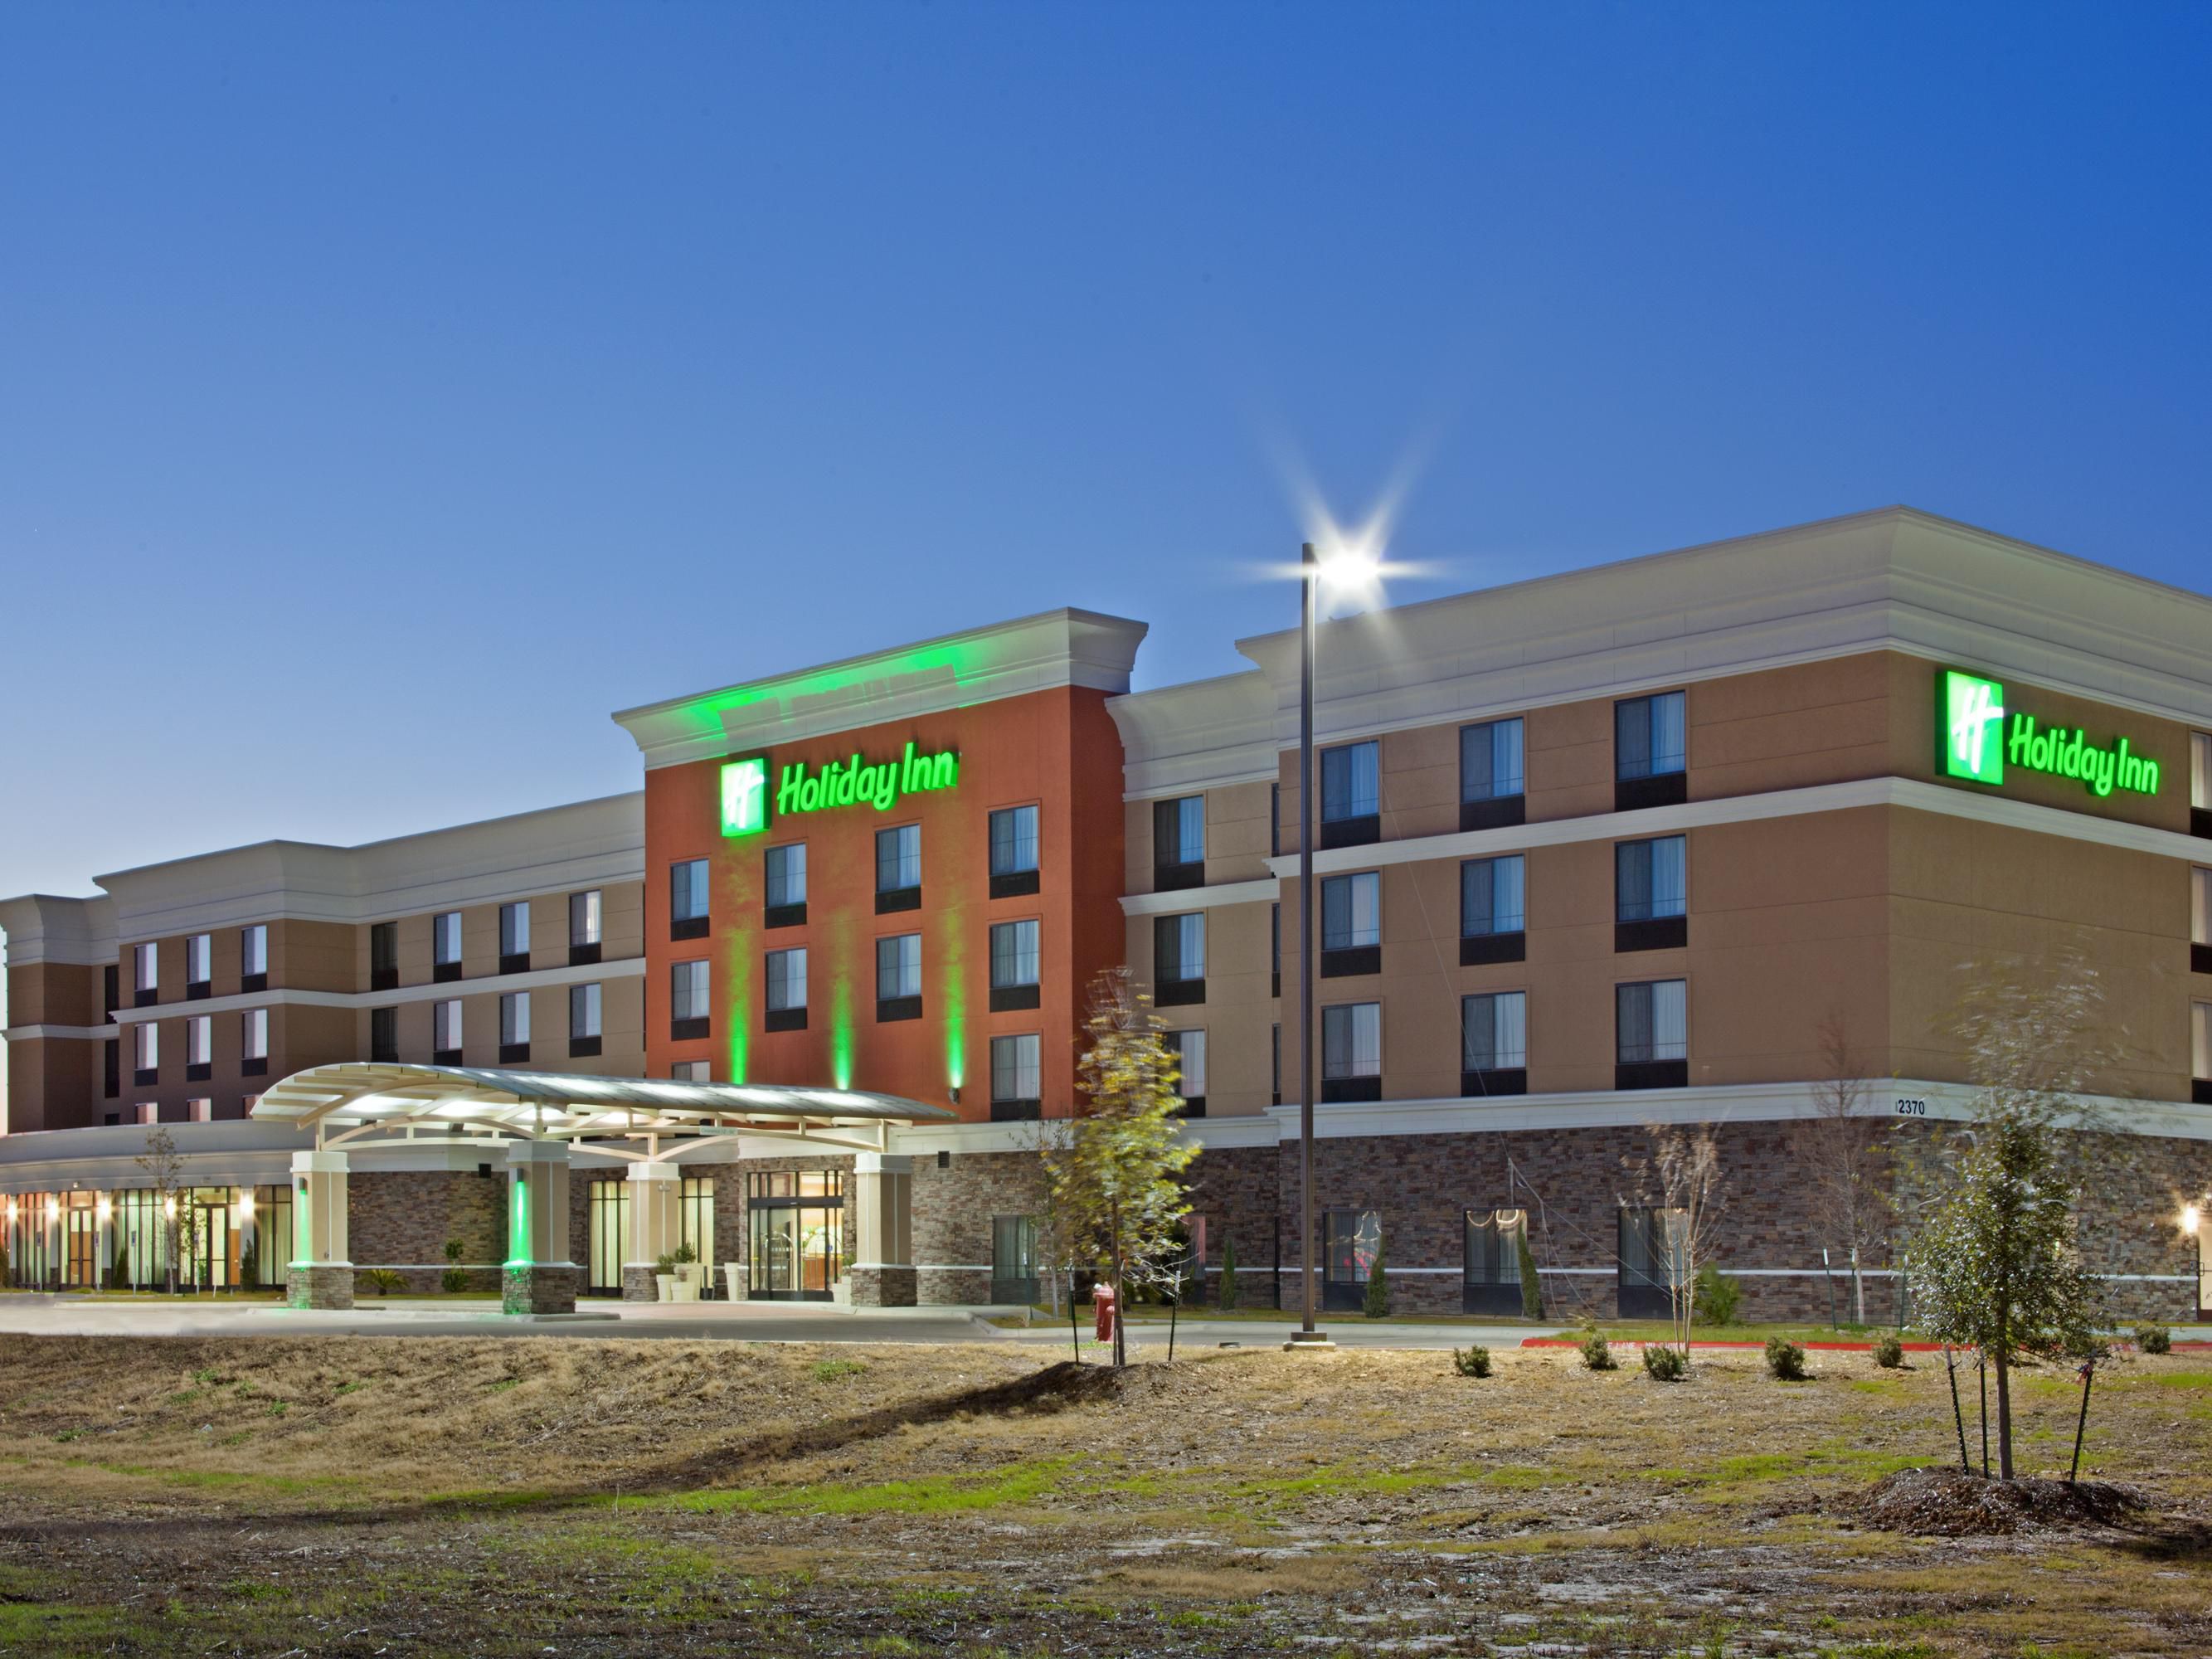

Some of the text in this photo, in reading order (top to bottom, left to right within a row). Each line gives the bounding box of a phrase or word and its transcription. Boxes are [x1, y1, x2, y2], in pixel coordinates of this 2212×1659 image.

[776, 742, 957, 815] Holiday Inn
[2009, 713, 2159, 796] Holiday Inn
[1898, 1099, 1925, 1115] 2370
